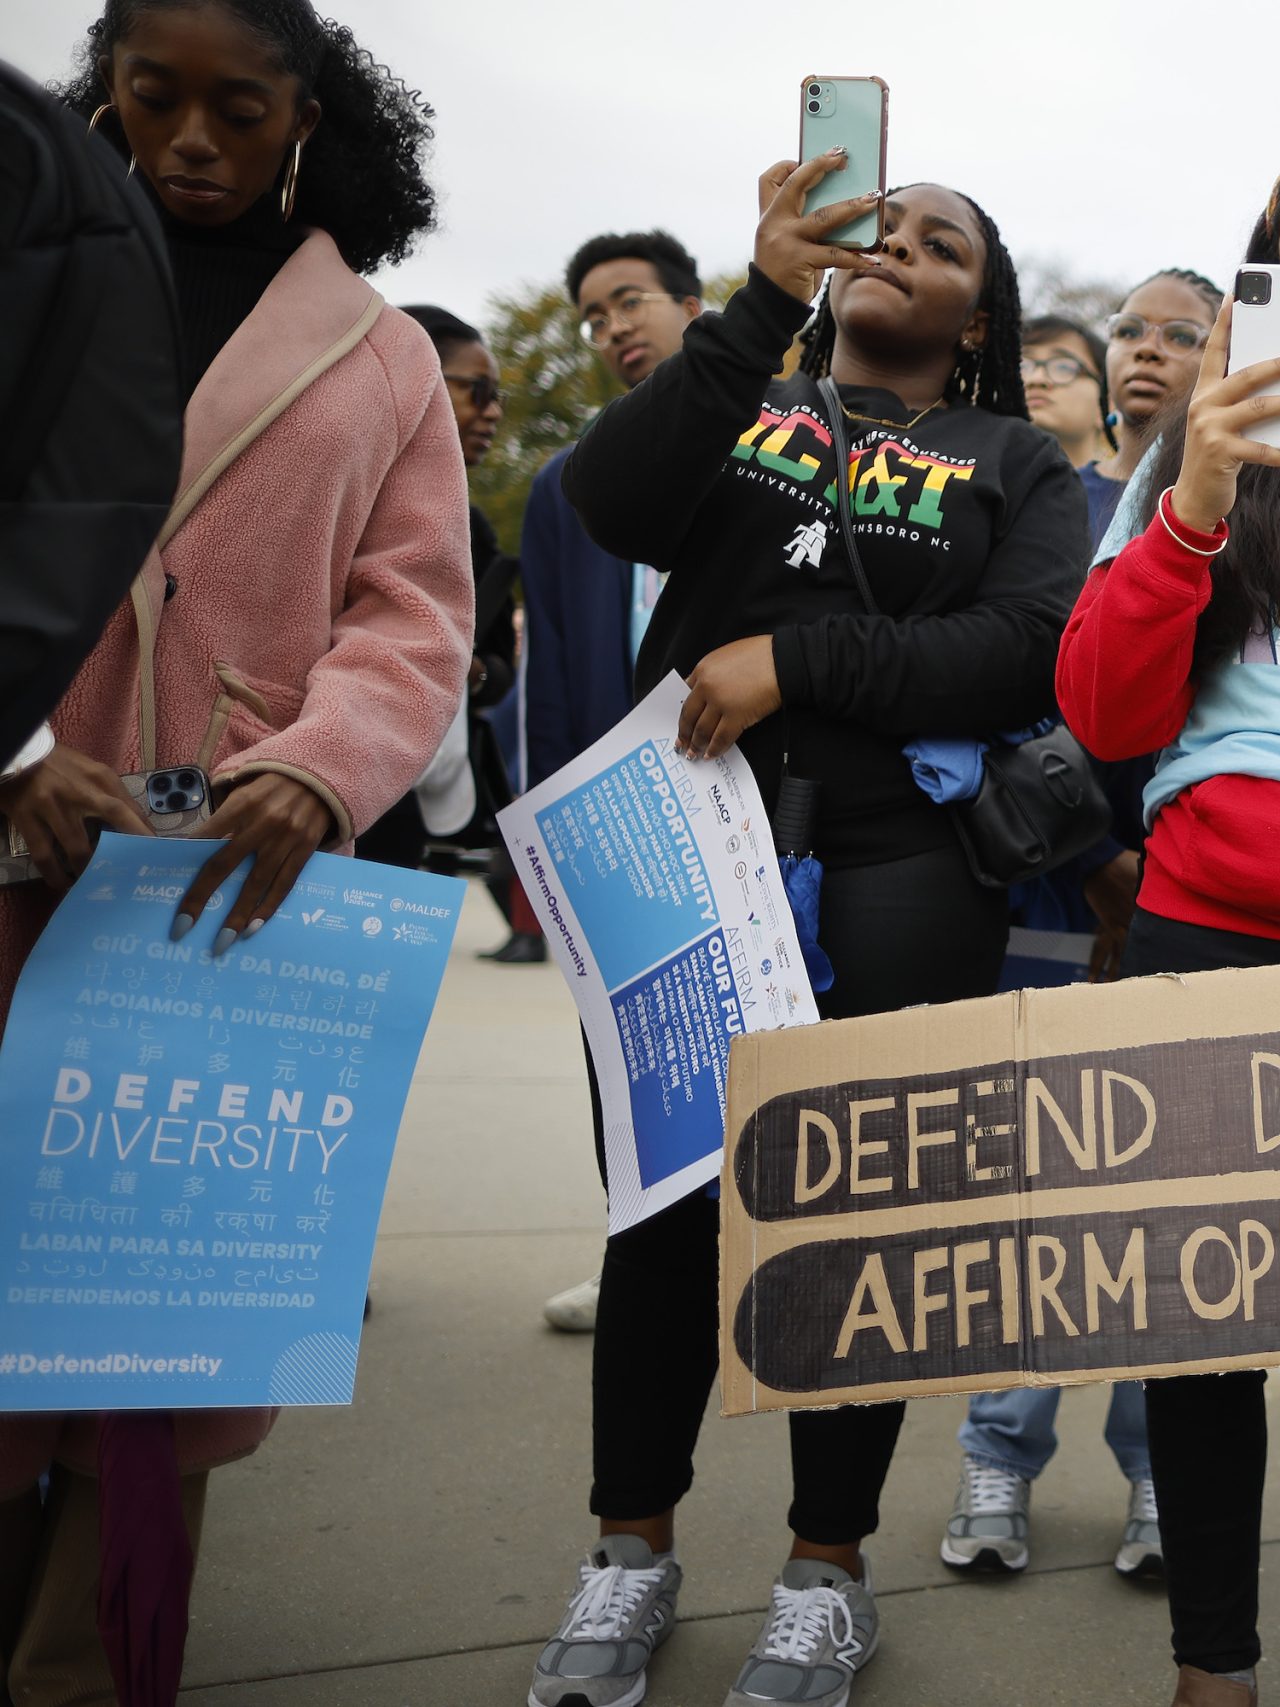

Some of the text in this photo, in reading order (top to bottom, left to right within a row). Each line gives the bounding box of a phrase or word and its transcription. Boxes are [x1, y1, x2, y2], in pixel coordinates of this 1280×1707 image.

[902, 437, 977, 466] EDUCATED
[736, 466, 832, 517] UNIVERSITY
[852, 523, 951, 551] ENSBORO NC
[655, 737, 702, 818] AFFIRM
[710, 784, 731, 824] NAACP
[591, 784, 626, 856] OPORTUNIDADE
[624, 863, 643, 898] TODOS
[609, 797, 620, 817] LAS
[616, 817, 654, 899] OPORTUNIDADES
[619, 764, 652, 834] OPORTUNIDAD
[648, 833, 663, 861] PARA
[660, 860, 669, 875] SA
[665, 874, 681, 907] LAHAT
[639, 748, 717, 922] OPPORTUNITY
[133, 885, 185, 898] NAACP
[348, 899, 376, 908] JUSTICE
[350, 889, 384, 899] ALLIANCE
[405, 902, 451, 918] MALDEF
[525, 845, 588, 977] #AffirmOpportunity
[708, 936, 732, 995] OUR
[725, 927, 757, 1012] AFFIRM
[75, 988, 374, 1040] APOIAMOS A DIVERSIDADE
[676, 984, 691, 1032] NUESTRO
[687, 1032, 699, 1075] FUTURO
[689, 951, 707, 1014] SAMA-SAMA
[703, 1013, 712, 1042] PARA
[708, 1041, 717, 1057] SA
[662, 971, 672, 990] SIM
[667, 990, 676, 1016] PARA
[674, 1026, 686, 1061] NOSSO
[681, 1061, 693, 1103] FUTURO
[54, 1067, 354, 1127] DEFEND
[40, 1107, 349, 1174] DIVERSITY
[794, 1069, 1156, 1203] DEFEND
[19, 1232, 323, 1261] LABAN PARA SA DIVERSITY
[7, 1286, 316, 1308] DEFENDEMOS LA DIVERSIDAD
[833, 1227, 1148, 1359] AFFIRM
[0, 1353, 222, 1377] #DefendDiversity
